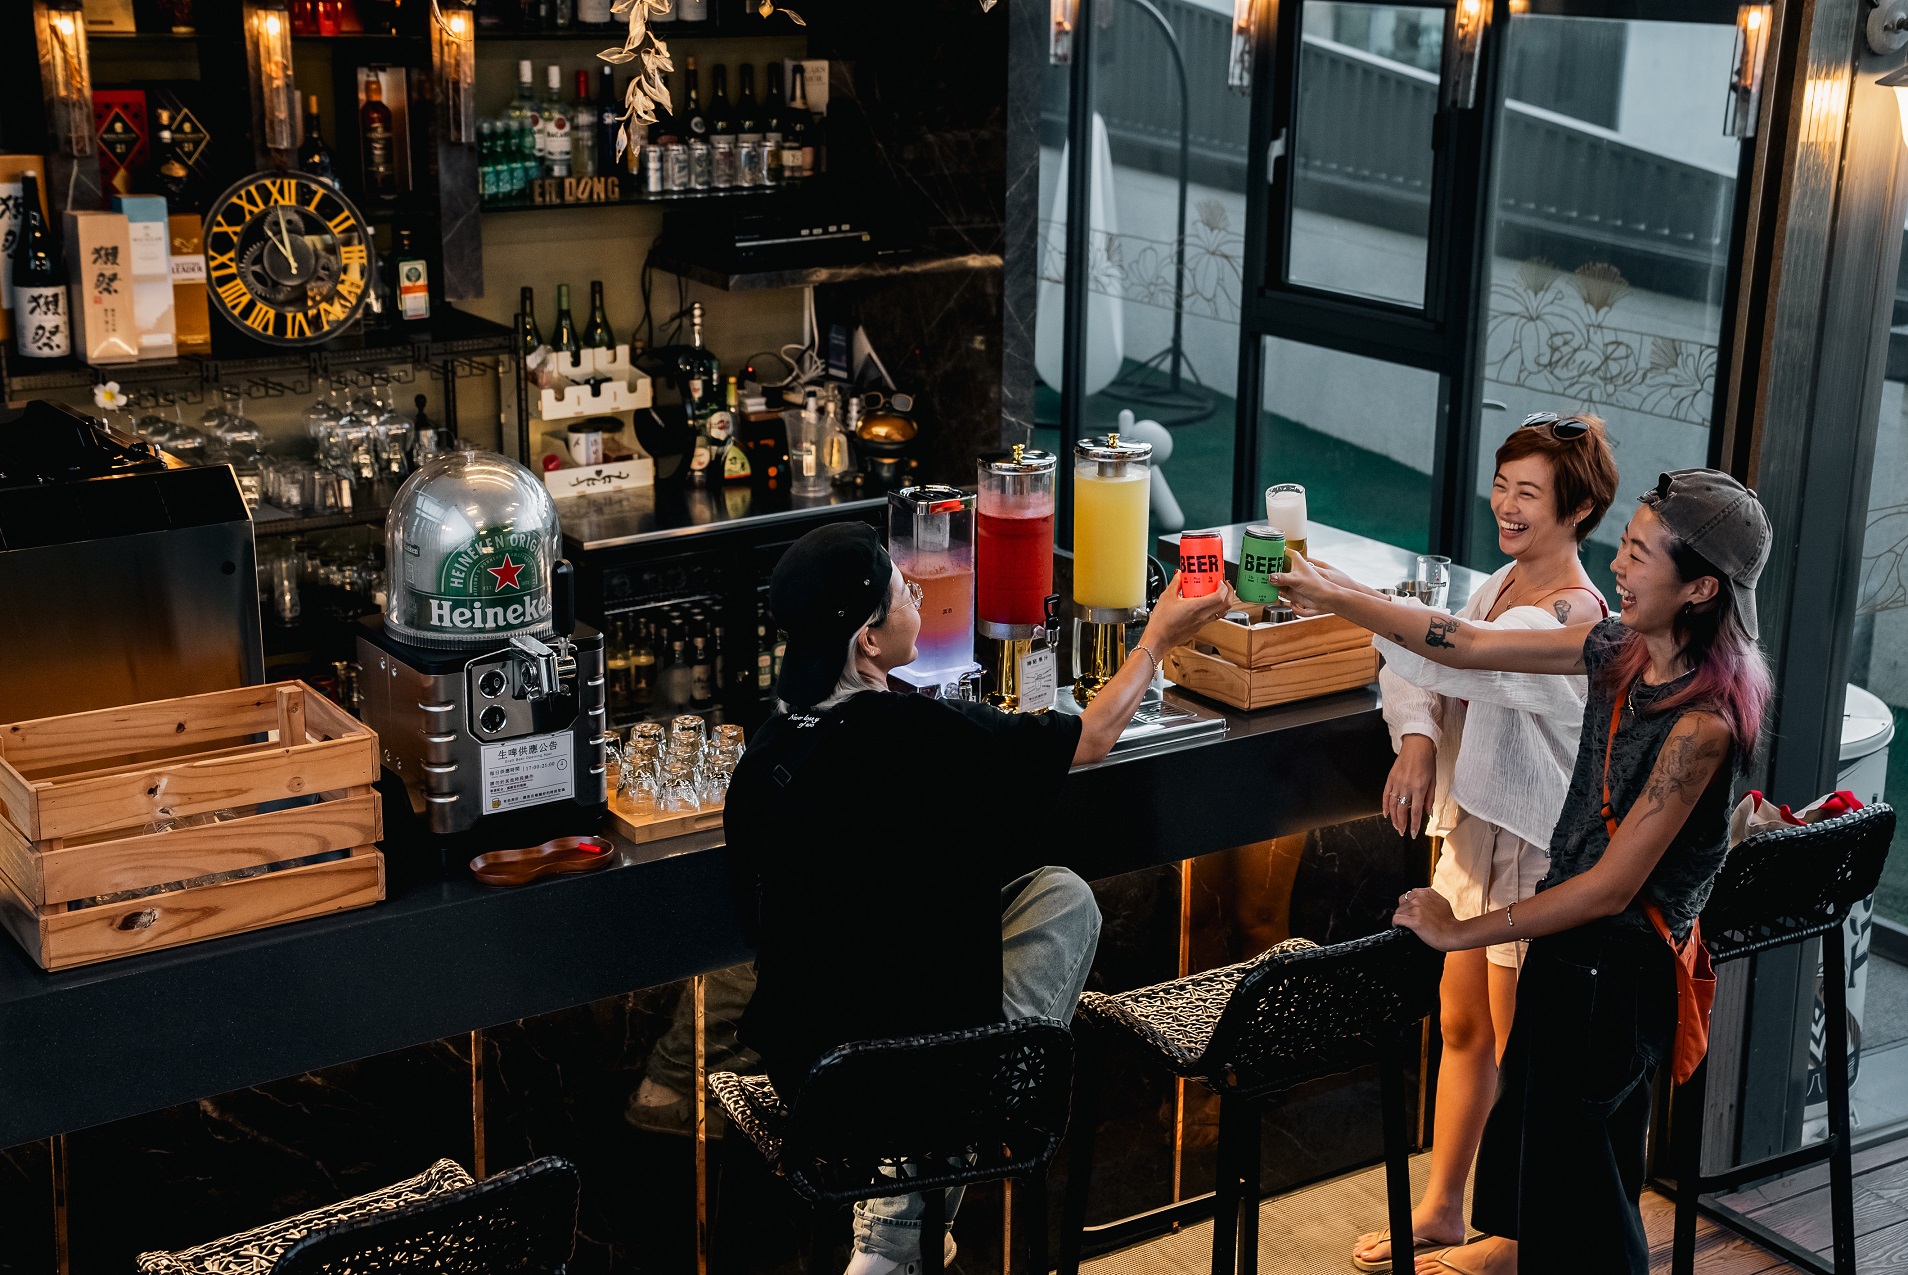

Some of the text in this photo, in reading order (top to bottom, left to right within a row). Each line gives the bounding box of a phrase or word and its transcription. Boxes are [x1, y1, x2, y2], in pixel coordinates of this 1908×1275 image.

[450, 534, 505, 588] HEINEKEN
[1180, 554, 1219, 574] BEER
[429, 595, 548, 628] Heineke
[497, 740, 558, 761] 生啤供應公告
